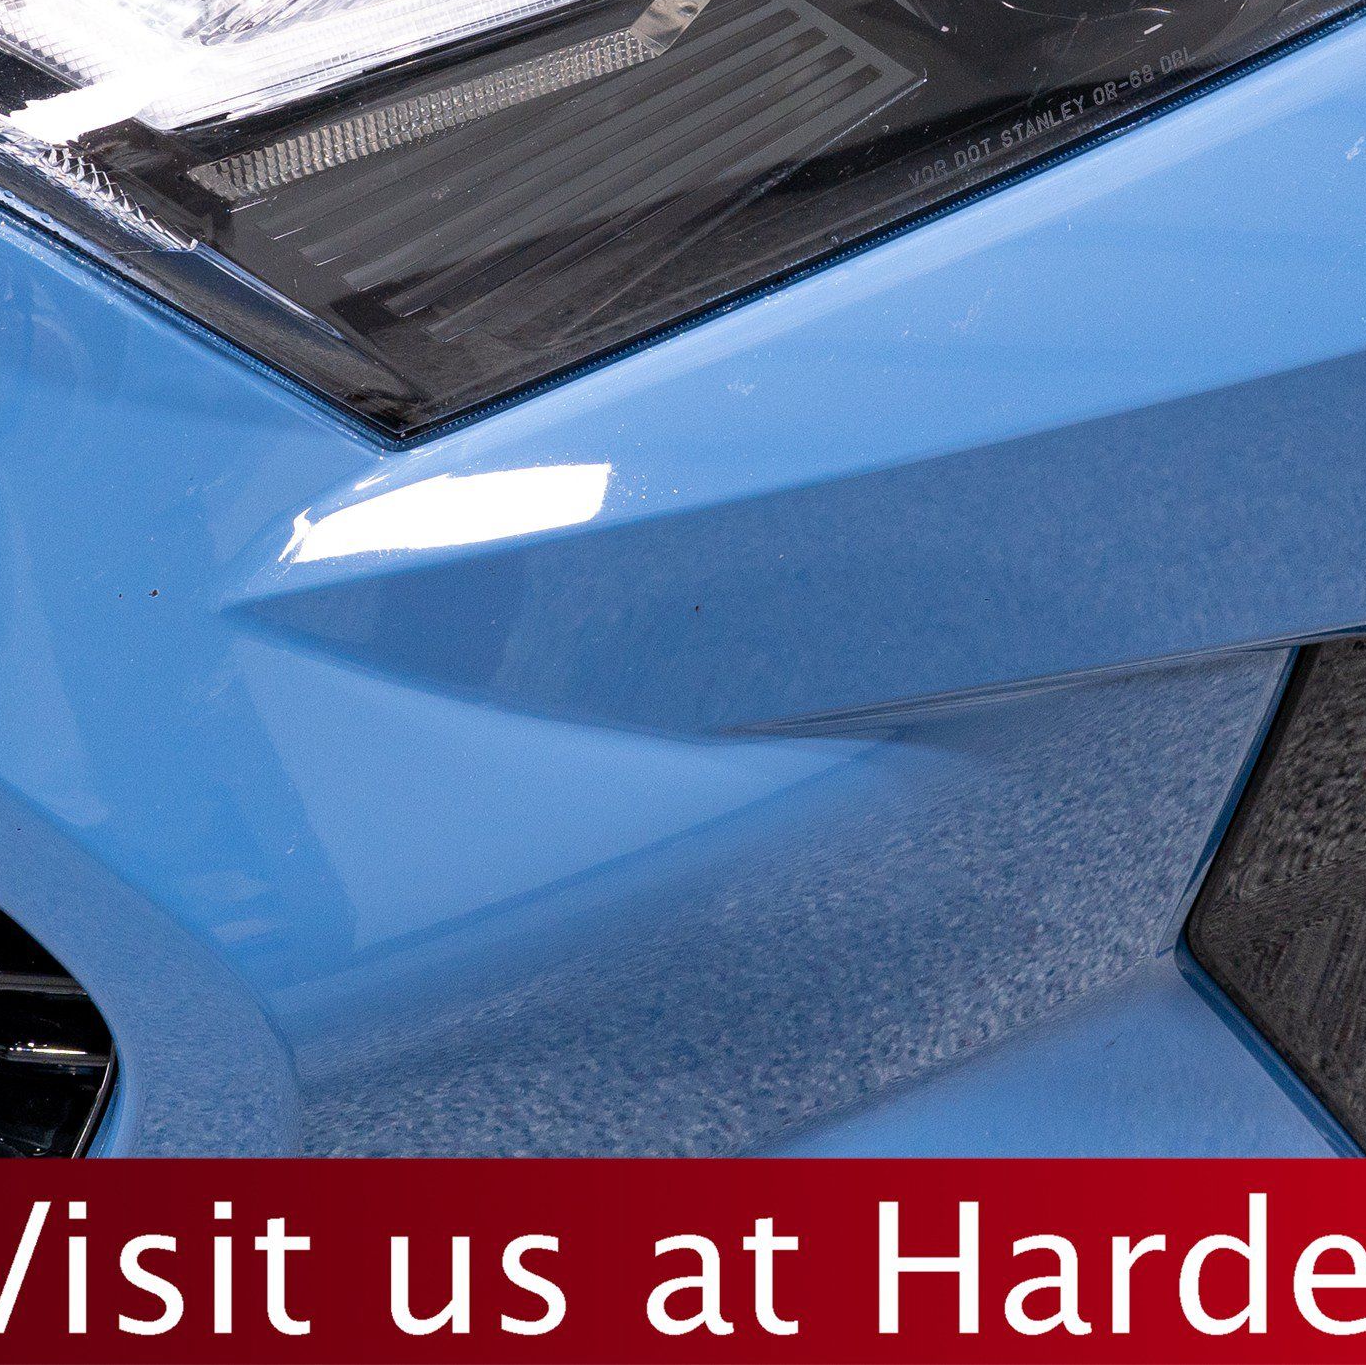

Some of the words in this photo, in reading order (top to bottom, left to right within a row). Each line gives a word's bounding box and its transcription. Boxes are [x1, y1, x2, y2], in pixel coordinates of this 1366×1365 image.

[908, 159, 949, 186] VOR
[954, 137, 992, 169] DOT
[1000, 95, 1085, 149] STANLEY
[1092, 64, 1155, 106] OR-68
[1159, 46, 1197, 75] DRL
